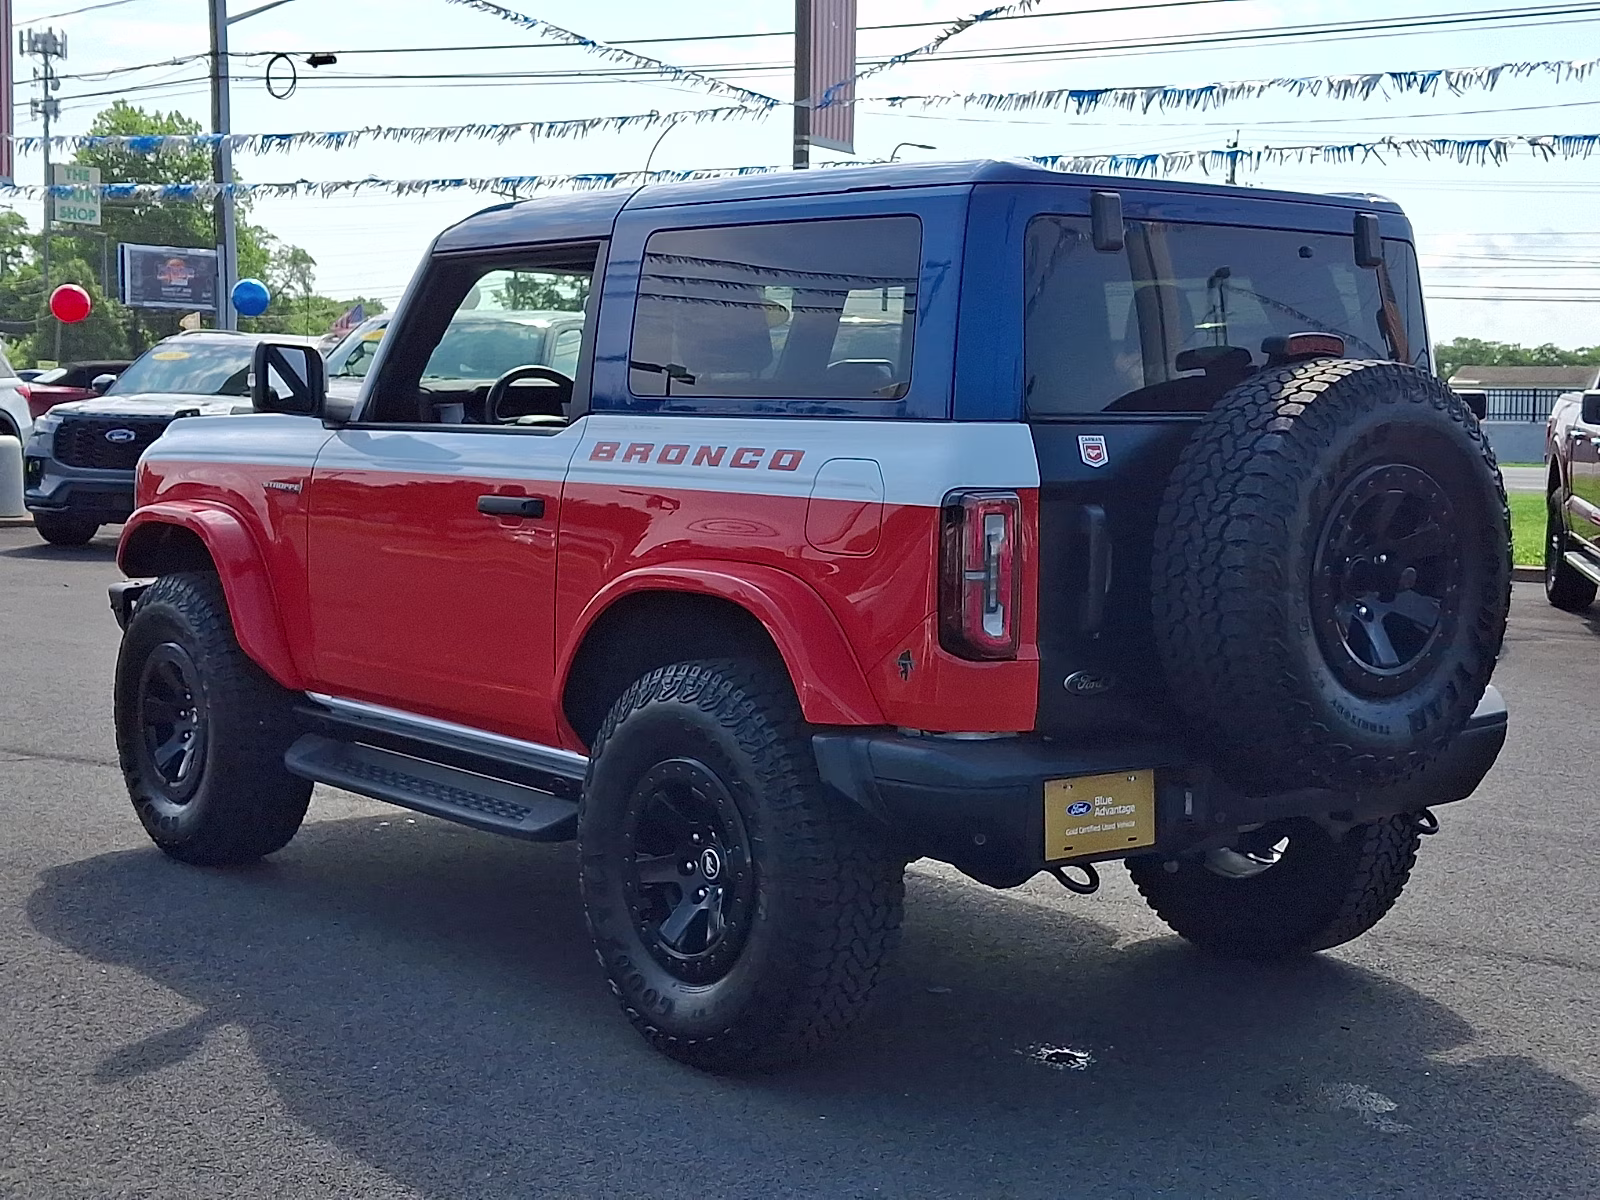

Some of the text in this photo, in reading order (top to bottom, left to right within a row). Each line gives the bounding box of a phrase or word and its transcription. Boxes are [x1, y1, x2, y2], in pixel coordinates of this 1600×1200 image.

[64, 168, 89, 181] THE
[60, 206, 97, 221] SHOP
[588, 441, 806, 472] BRONCO
[1074, 673, 1106, 692] Ford
[1094, 796, 1113, 805] Blue
[1069, 802, 1090, 815] Ford
[1094, 804, 1136, 817] Advantage
[1079, 825, 1101, 834] Certified
